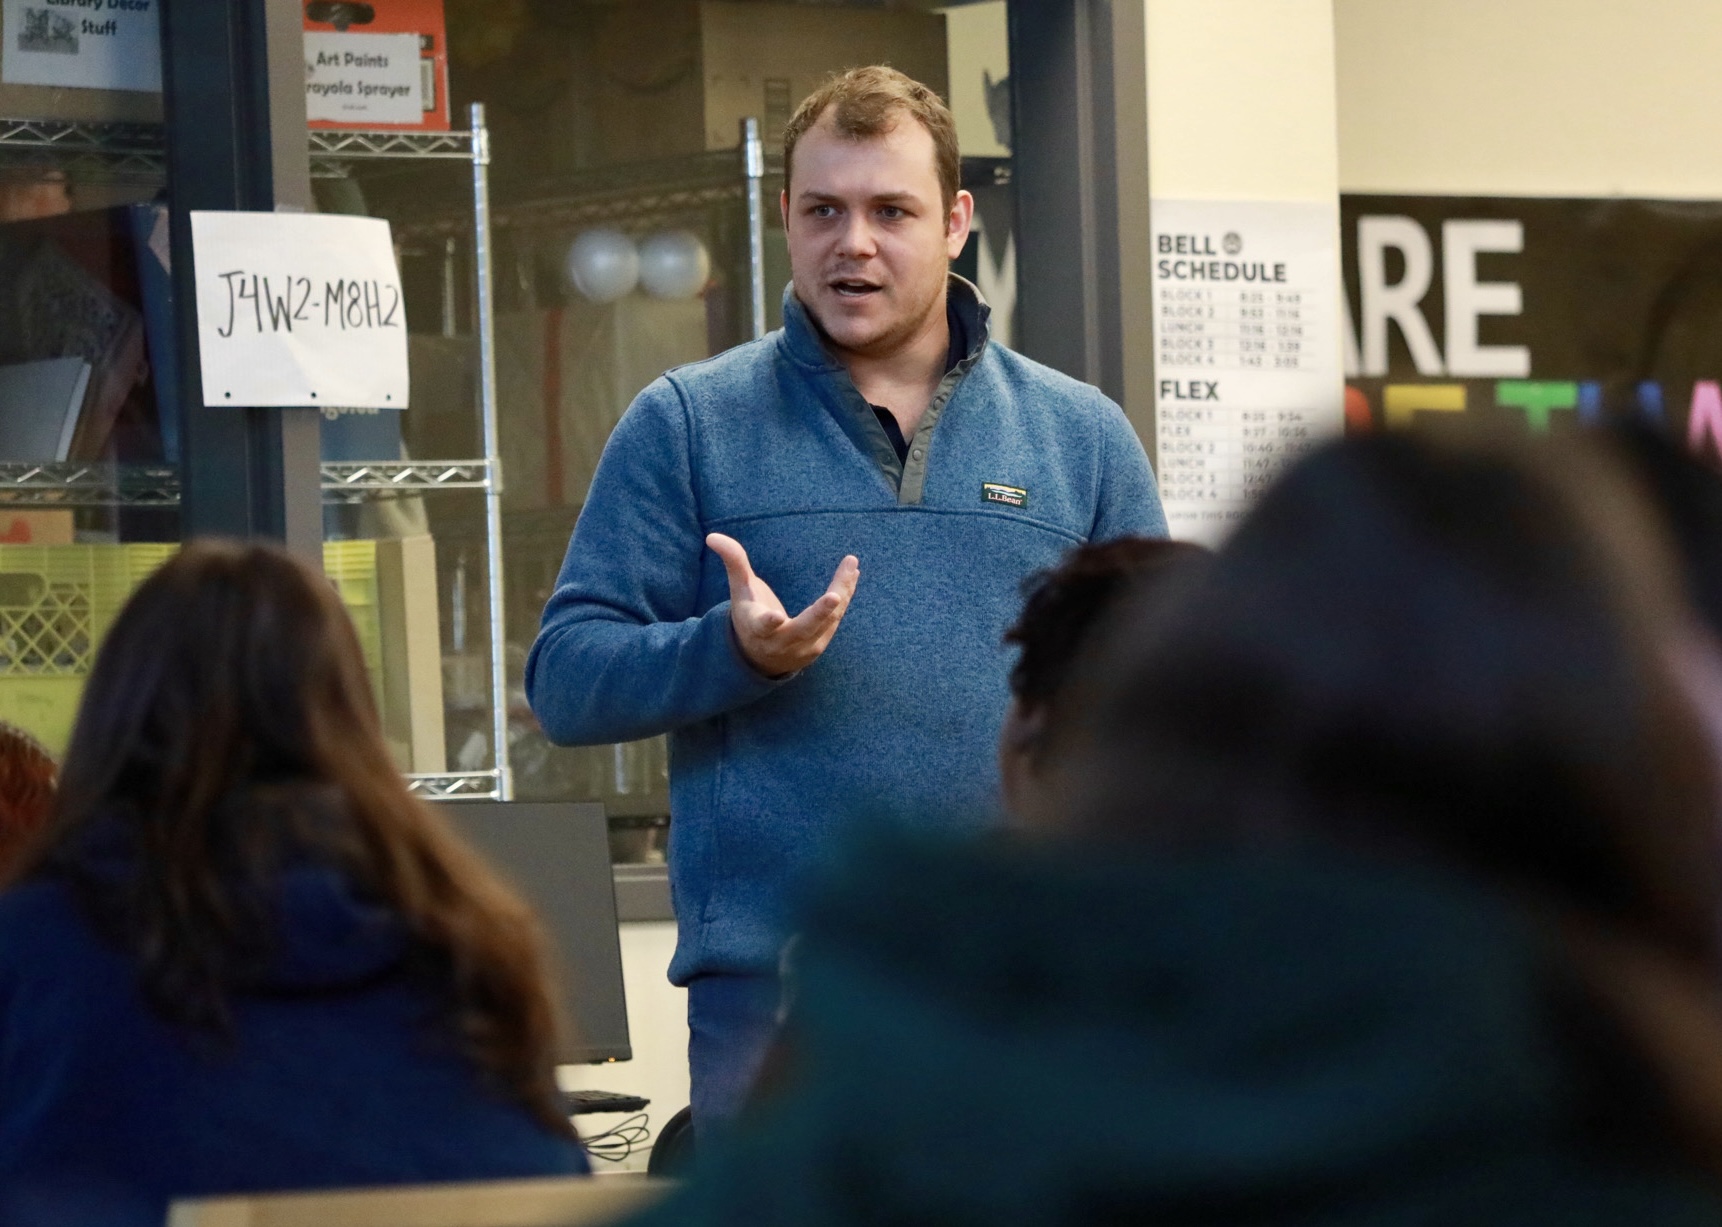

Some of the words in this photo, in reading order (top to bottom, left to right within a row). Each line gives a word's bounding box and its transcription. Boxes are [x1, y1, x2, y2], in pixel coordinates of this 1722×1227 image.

[81, 19, 117, 35] Stuff
[316, 51, 339, 66] Art
[344, 52, 388, 68] Paints
[306, 80, 352, 97] rayola
[357, 80, 410, 98] Sprayer
[1158, 234, 1216, 256] BELL
[1158, 260, 1287, 283] SCHEDULE
[1160, 290, 1201, 301] BLOCK
[217, 270, 399, 338] J4W2-M8H2
[1161, 306, 1202, 318] BLOCK
[1160, 323, 1204, 334] LUNCH
[1160, 338, 1201, 350] BLOCK
[1160, 354, 1201, 366] BLOCK
[1160, 380, 1219, 400] FLEX
[1160, 410, 1201, 421] BLOCK
[1160, 426, 1190, 437] FLEX
[1161, 442, 1202, 453] BLOCK
[1161, 458, 1205, 469] LUNCH
[1161, 474, 1202, 485] BLOCK
[1162, 489, 1203, 501] BLOCK
